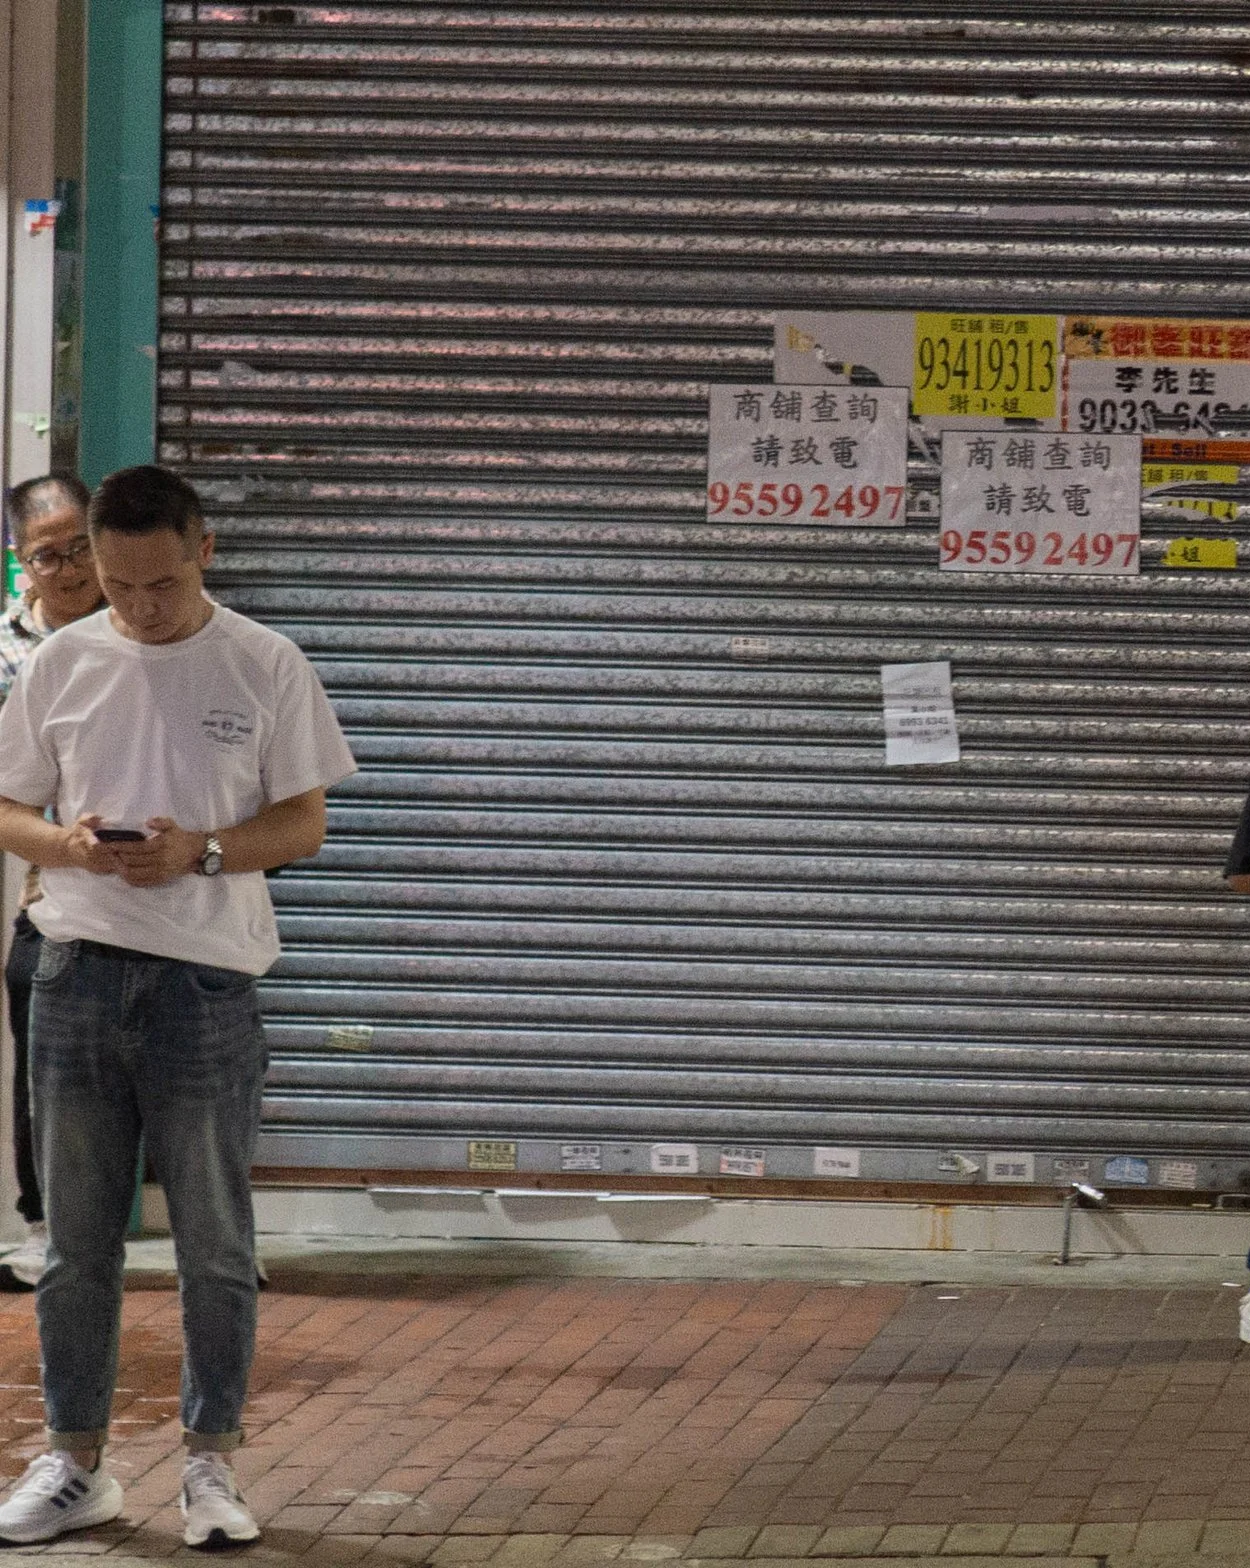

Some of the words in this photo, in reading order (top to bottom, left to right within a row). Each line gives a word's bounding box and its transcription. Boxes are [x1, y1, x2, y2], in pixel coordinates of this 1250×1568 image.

[919, 336, 1055, 392] 93419313
[1114, 366, 1216, 395] 李先生
[733, 389, 879, 424] 商舖查詢
[949, 394, 1022, 414] 謝小姐
[750, 434, 859, 469] 請致電
[965, 437, 1112, 471] 商舖查詢
[709, 481, 802, 518] 9559
[809, 481, 905, 519] 2497
[982, 482, 1094, 517] 請致電
[938, 529, 1036, 566] 9559
[1042, 530, 1139, 567] 2497
